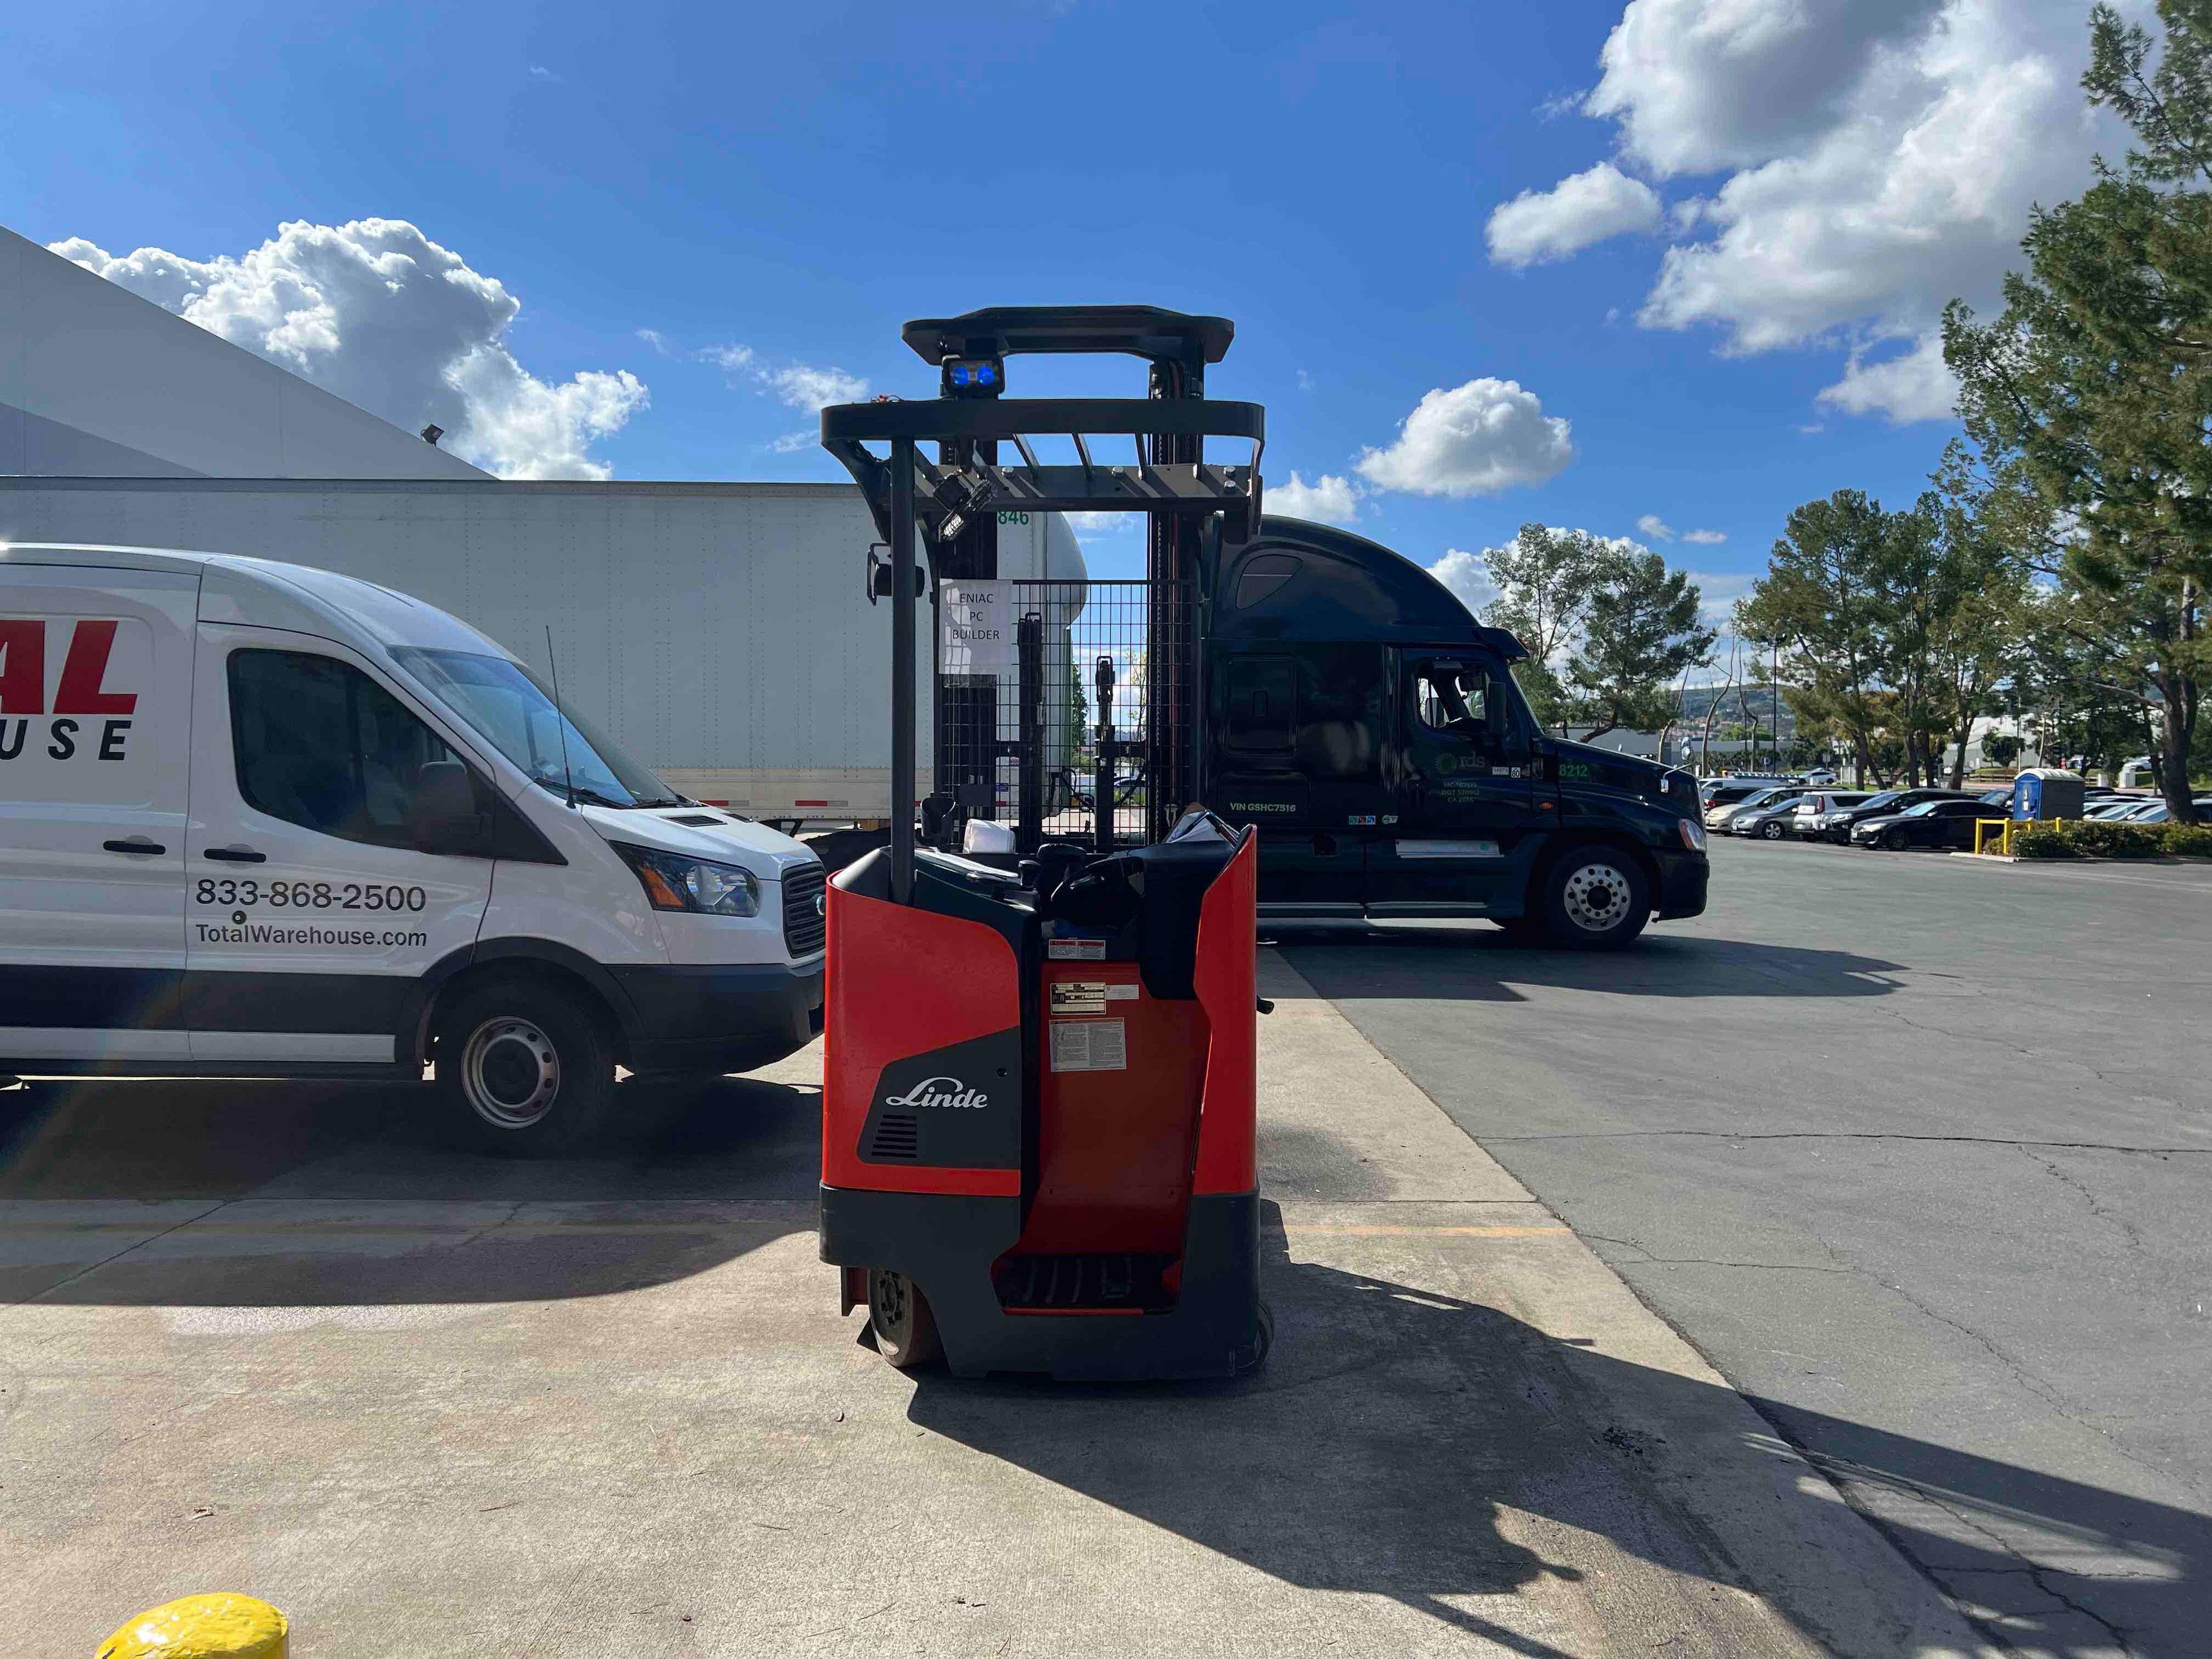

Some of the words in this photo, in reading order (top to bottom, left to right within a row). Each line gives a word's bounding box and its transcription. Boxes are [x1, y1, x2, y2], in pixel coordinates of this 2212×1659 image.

[960, 593, 994, 603] ENIAC
[970, 612, 983, 621] PC
[952, 630, 999, 639] BUILDER
[1559, 764, 1588, 777] 8212
[1230, 802, 1245, 810] VIN
[196, 879, 426, 911] 833-868-2500
[196, 924, 427, 946] TotalWarehouse.com
[885, 1077, 988, 1108] Linde
